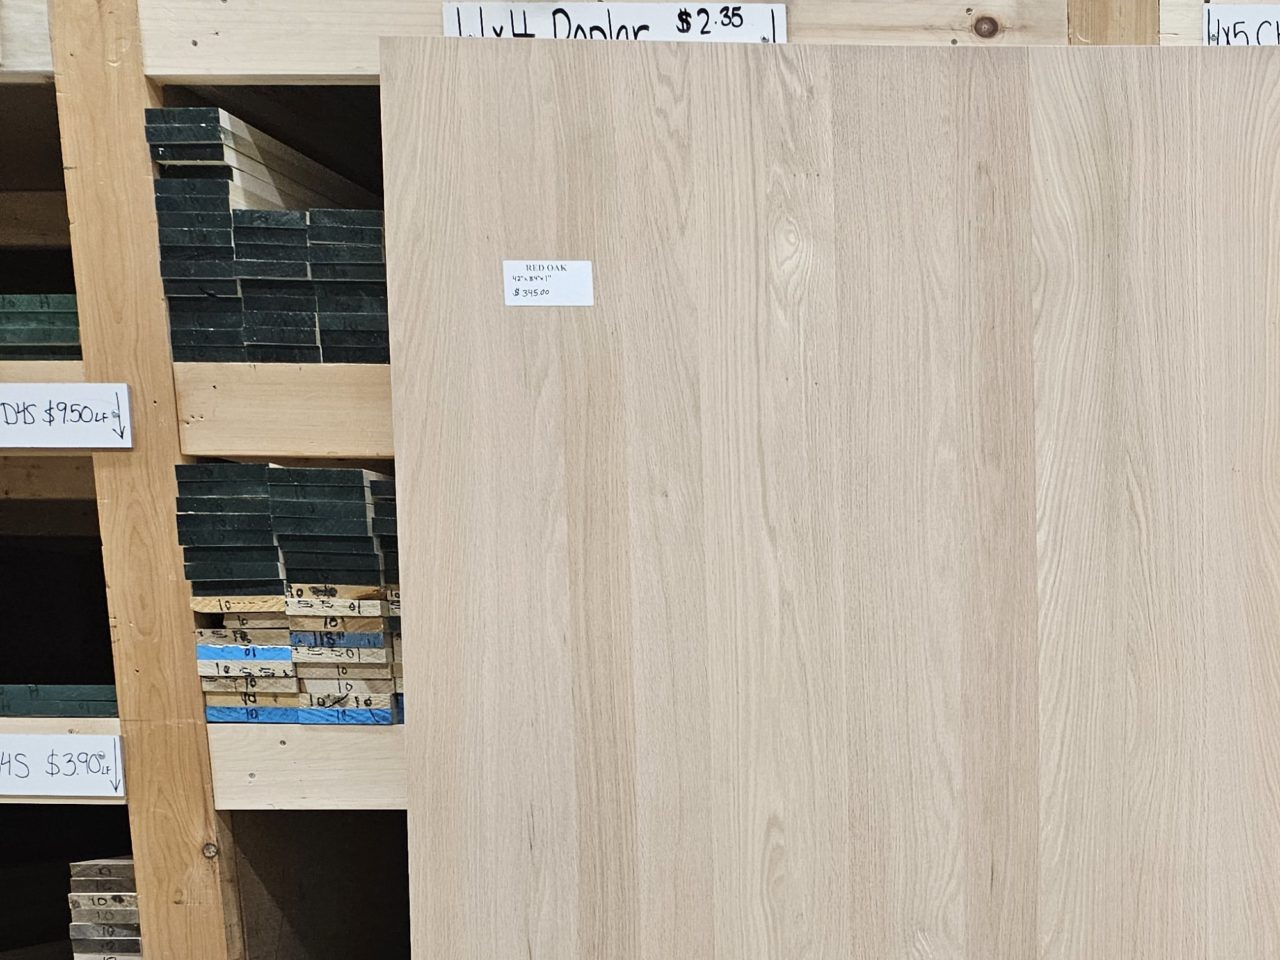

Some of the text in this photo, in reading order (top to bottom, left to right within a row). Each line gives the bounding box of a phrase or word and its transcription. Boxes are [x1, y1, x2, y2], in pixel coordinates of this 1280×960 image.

[676, 6, 744, 35] $2.35
[525, 264, 568, 272] RED OAK
